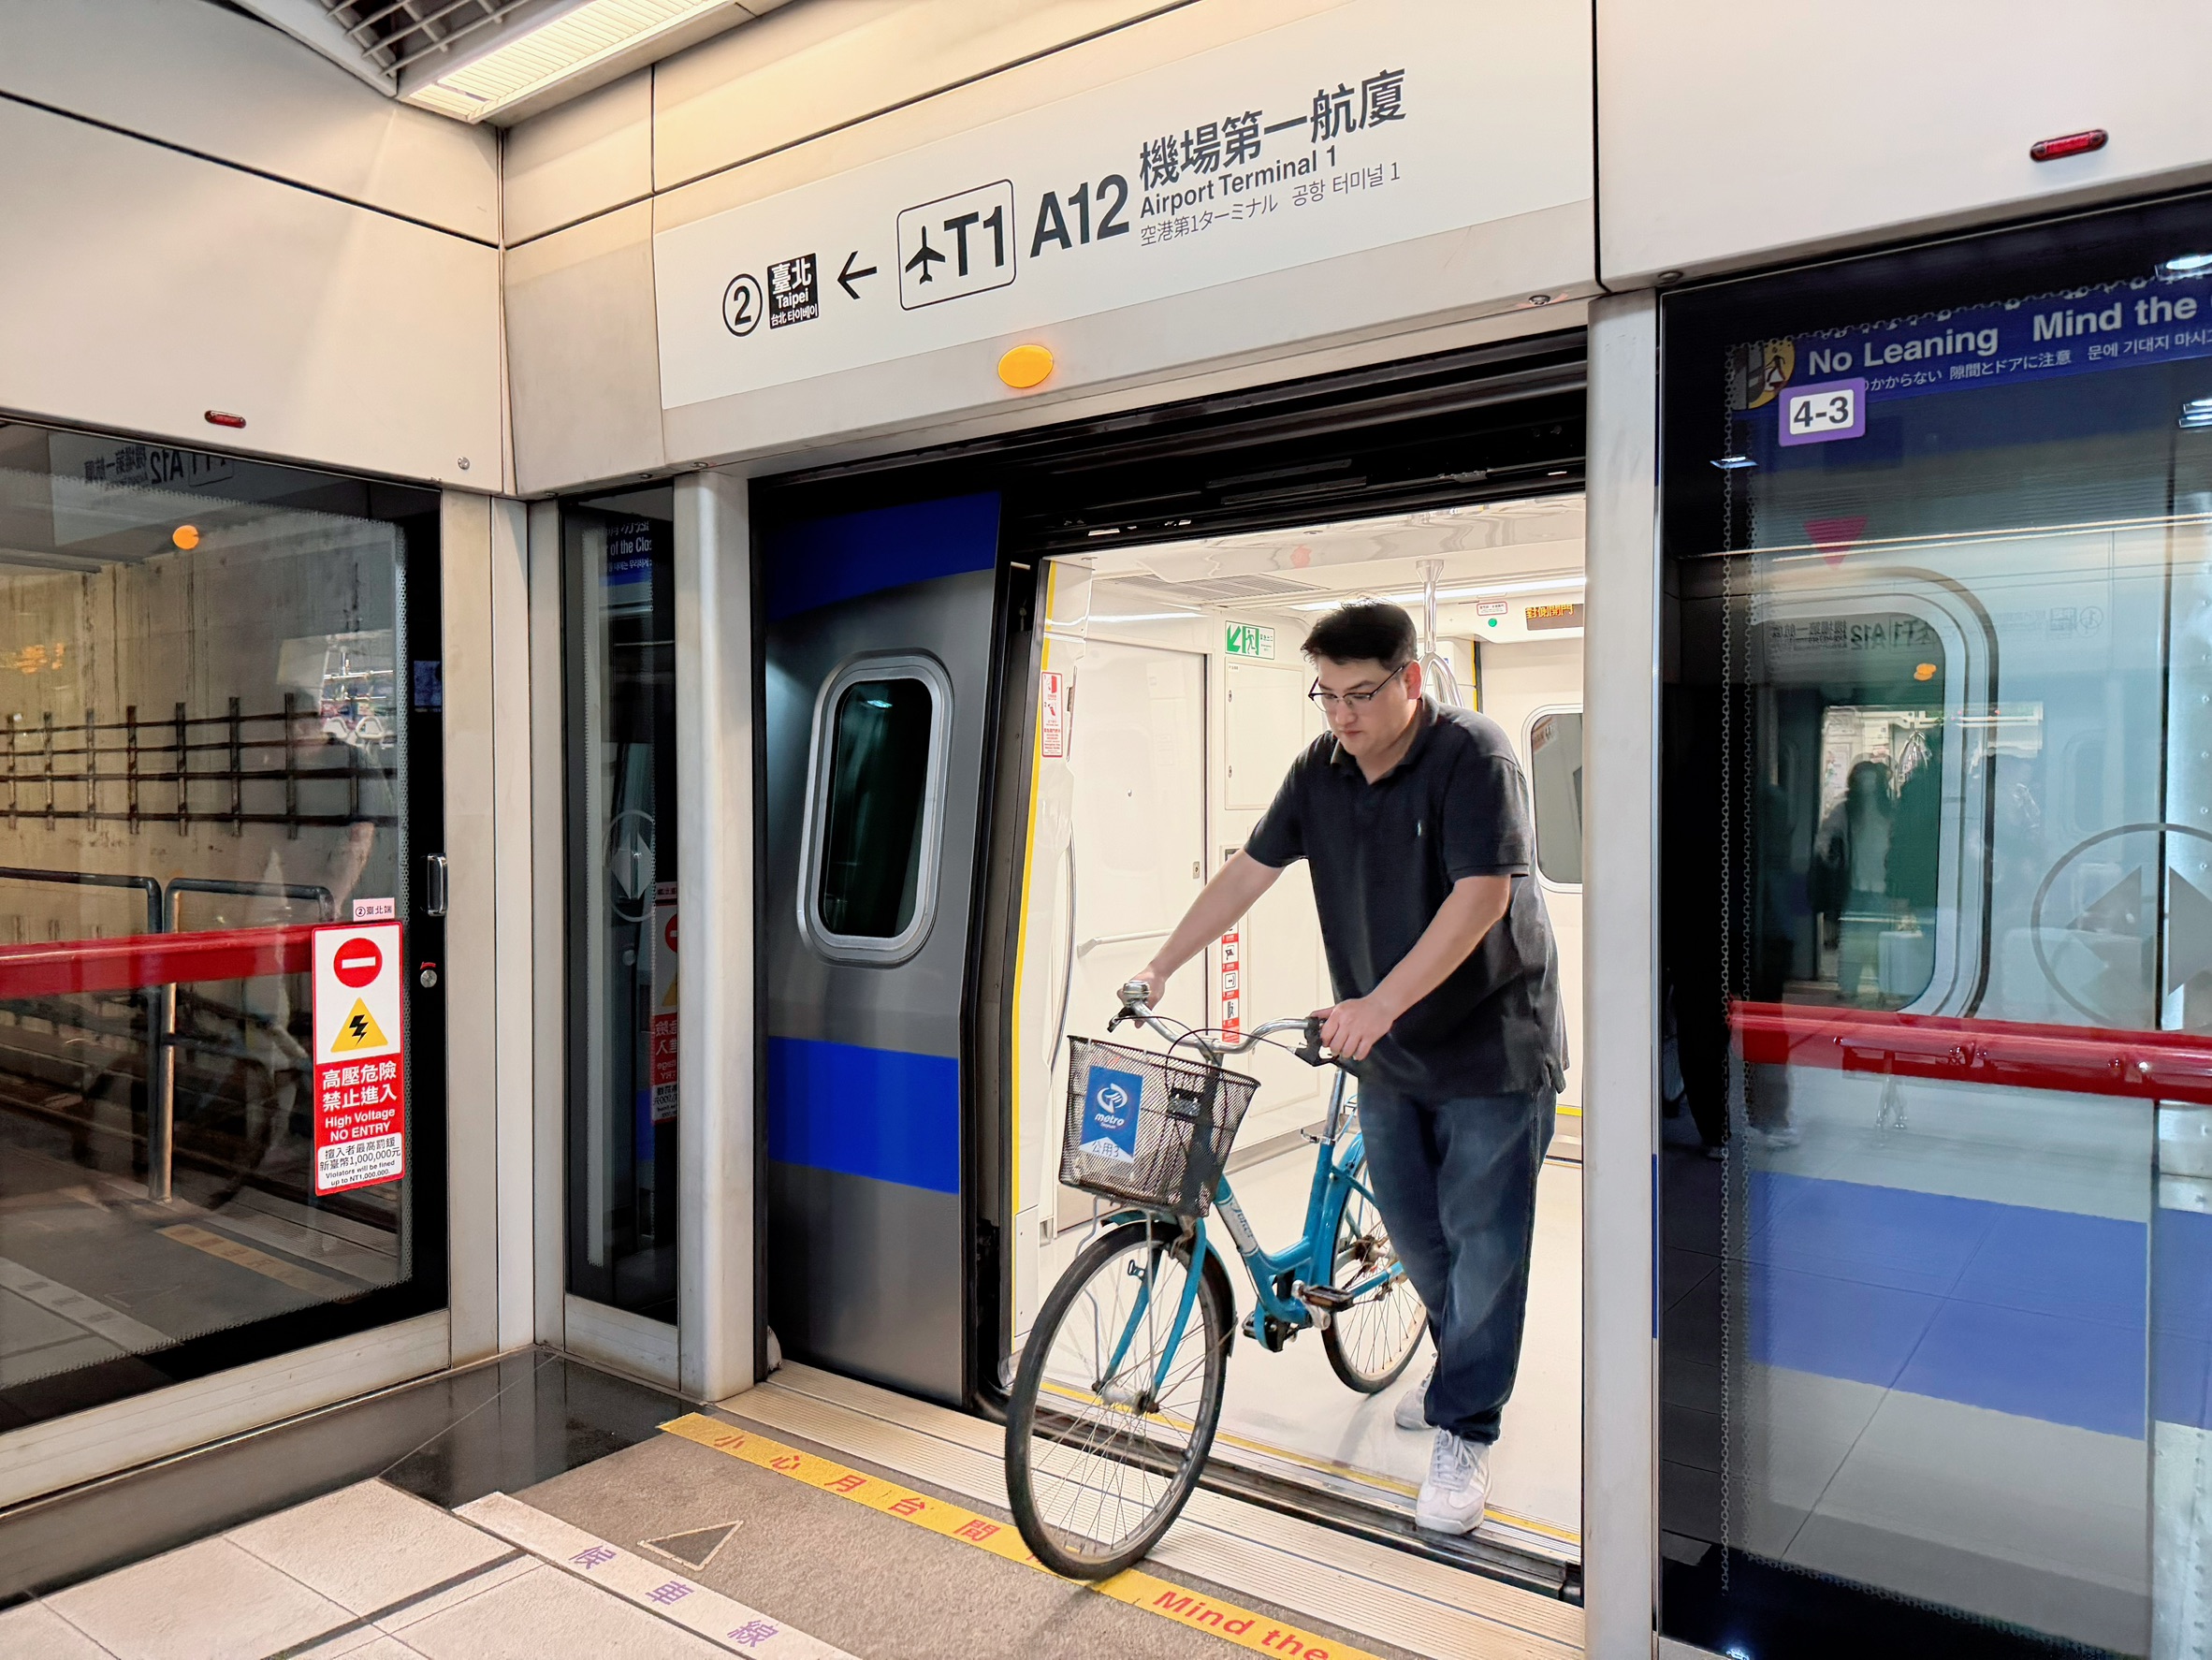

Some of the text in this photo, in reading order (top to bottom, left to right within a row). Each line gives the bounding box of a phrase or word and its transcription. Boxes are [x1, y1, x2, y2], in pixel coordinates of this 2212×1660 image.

[1139, 67, 1407, 192] 機場第一航廈
[1140, 144, 1336, 219] Airport Terminal 1
[1291, 161, 1401, 207] 공항 터미널 1
[1029, 173, 1130, 259] A12
[1140, 194, 1278, 247] 空港第1ターミナル
[943, 204, 1005, 278] T1
[771, 257, 812, 295] 臺北
[775, 287, 809, 309] Taipei
[1809, 348, 1854, 376] No
[1863, 328, 1999, 367] Leaning
[2032, 301, 2122, 342] Mind
[2134, 296, 2198, 327] the
[2087, 343, 2118, 361] 문에
[2122, 334, 2170, 356] 기대지
[1793, 396, 1849, 428] 4-3
[620, 539, 633, 555] the
[322, 1060, 397, 1091] 高壓危險
[322, 1083, 398, 1114] 禁止進入
[325, 1108, 396, 1129] High Voltage
[330, 1120, 391, 1143] NO ENTRY
[1094, 1113, 1126, 1128] metro
[713, 1433, 1041, 1564] 小心月台間
[1152, 1590, 1330, 1660] Mind the
